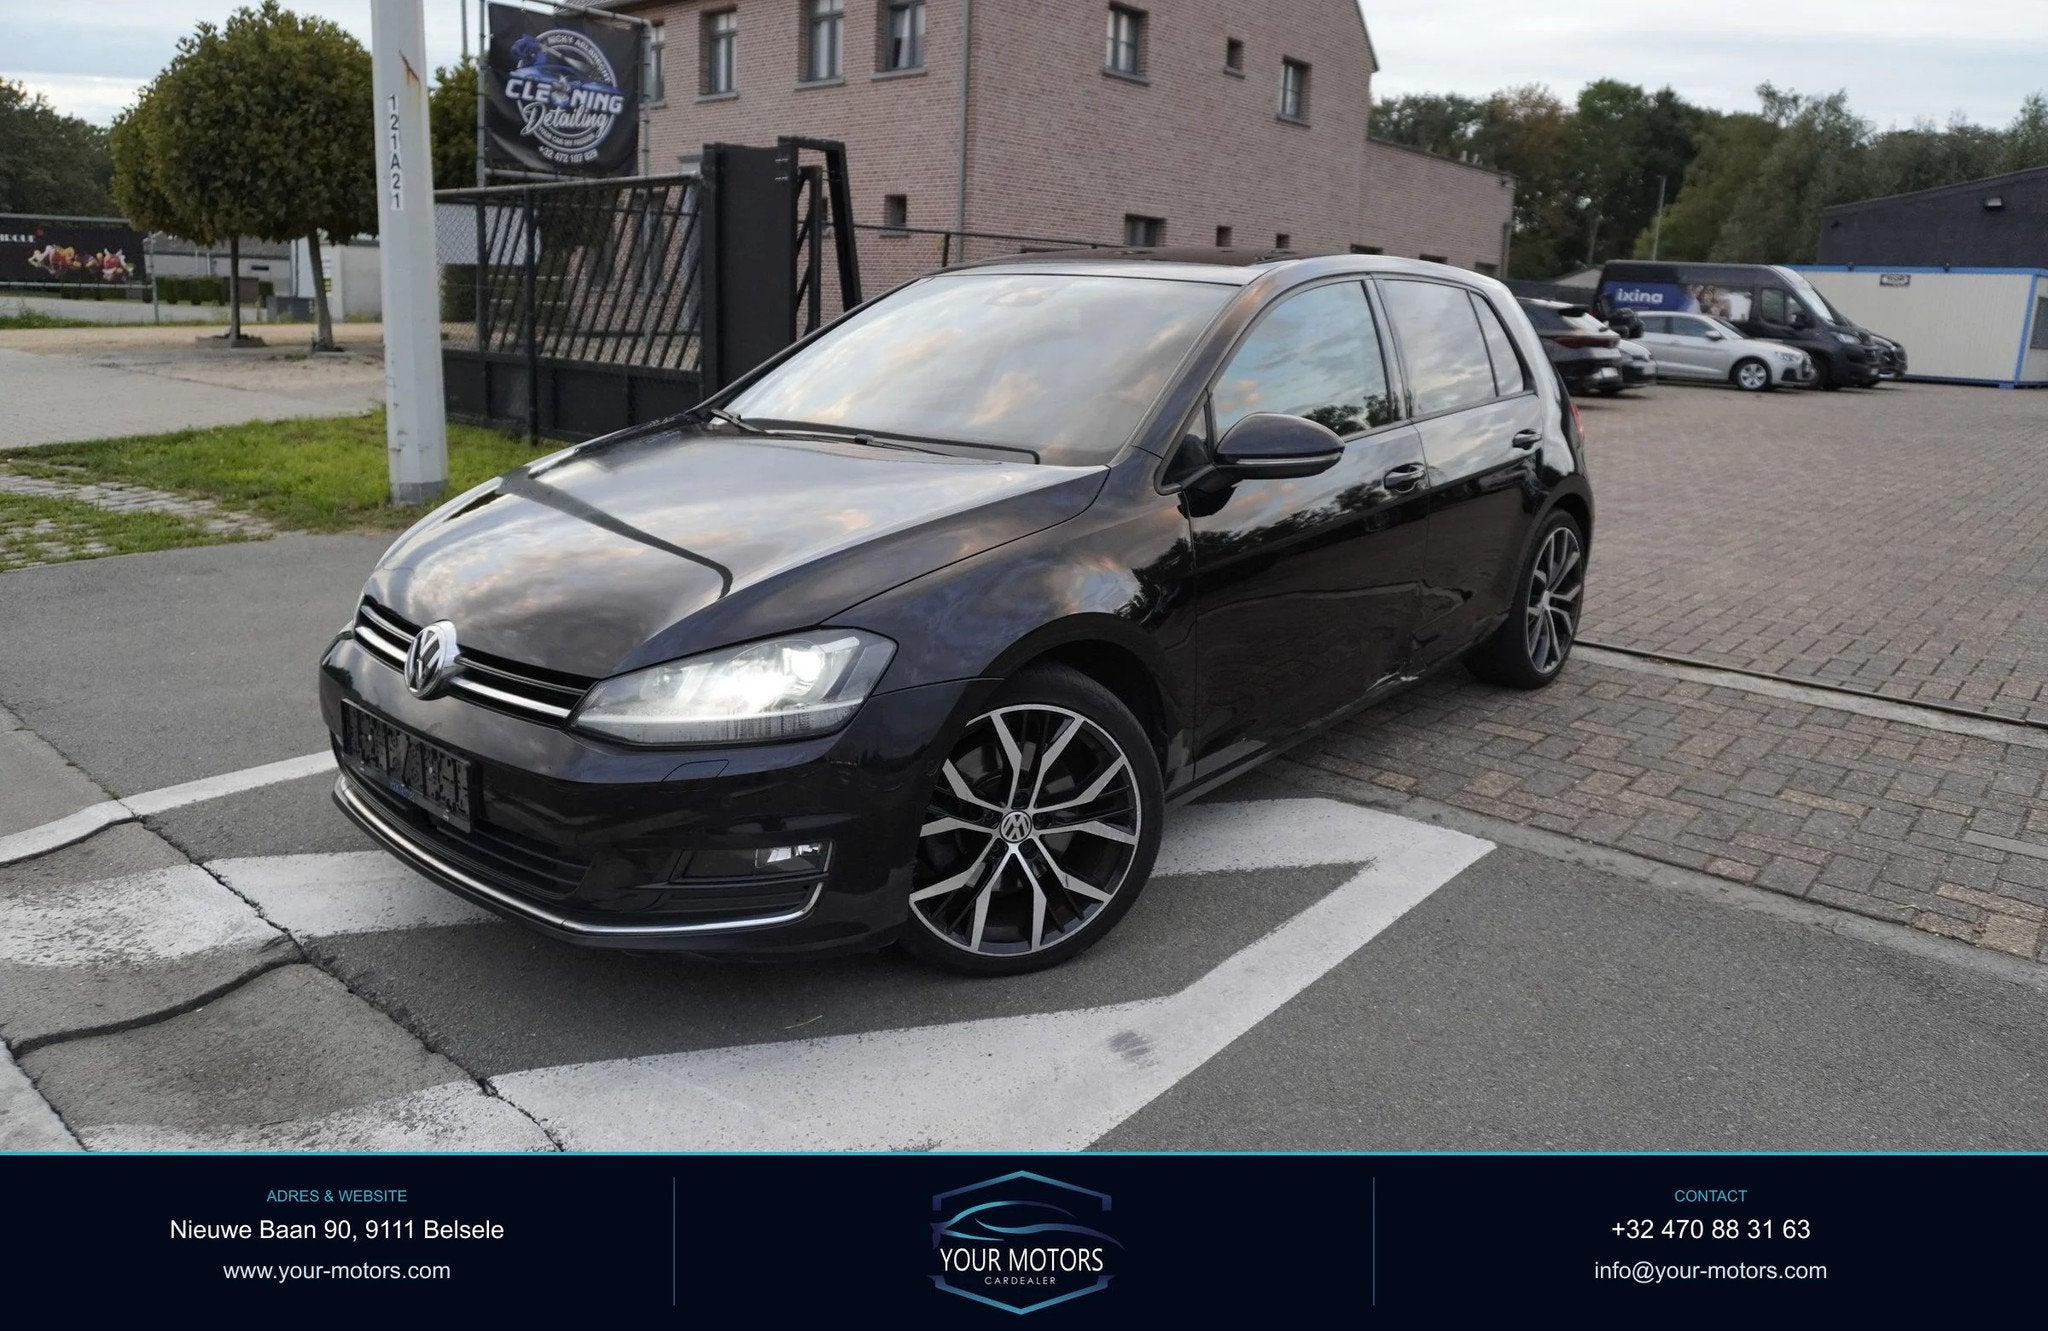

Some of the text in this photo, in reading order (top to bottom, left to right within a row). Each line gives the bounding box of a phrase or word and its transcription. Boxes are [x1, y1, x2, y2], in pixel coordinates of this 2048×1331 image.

[505, 78, 625, 115] CLENING
[520, 102, 611, 137] Detailing
[1617, 287, 1664, 304] ixina
